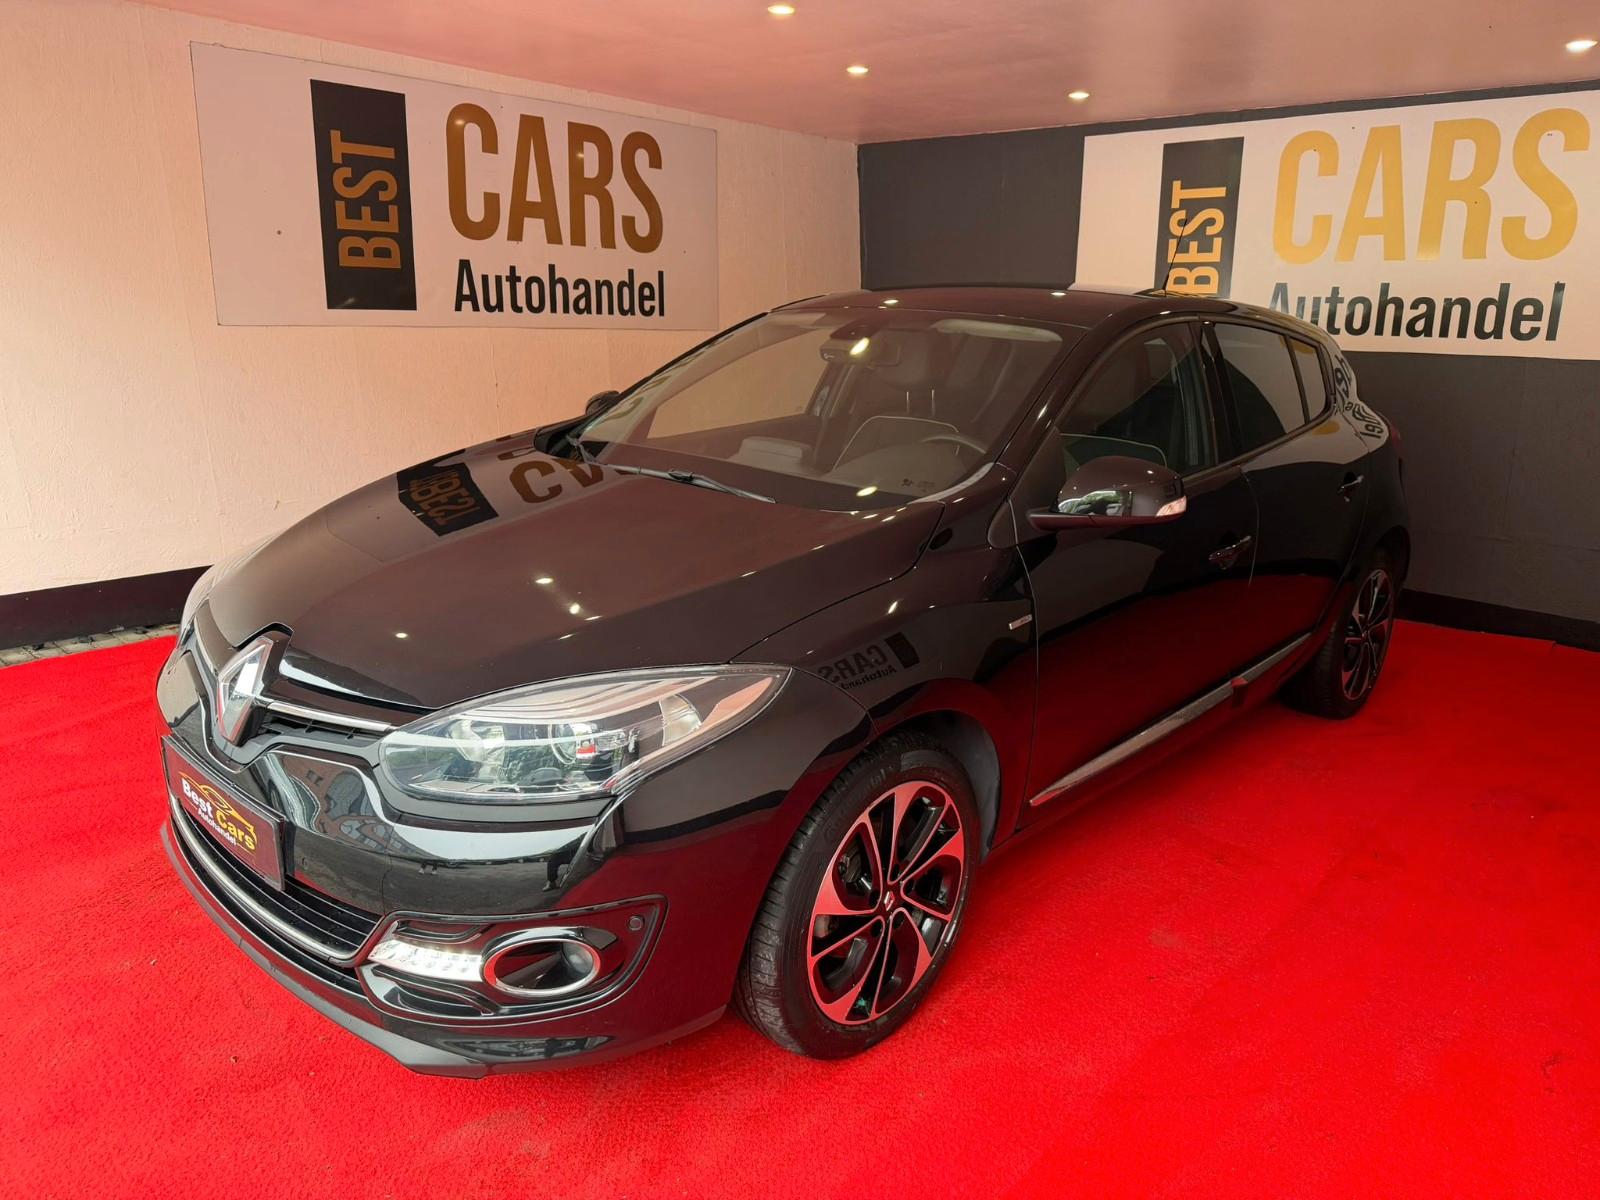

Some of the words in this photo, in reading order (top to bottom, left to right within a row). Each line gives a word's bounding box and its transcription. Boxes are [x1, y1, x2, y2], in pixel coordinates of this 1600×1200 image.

[330, 129, 402, 268] BEST
[446, 103, 663, 253] CARS
[1273, 107, 1590, 264] CARS
[454, 259, 666, 317] Autohandel
[1167, 180, 1227, 294] BEST
[181, 778, 214, 819] Best
[215, 810, 256, 850] Cars
[198, 809, 237, 846] Autohandel
